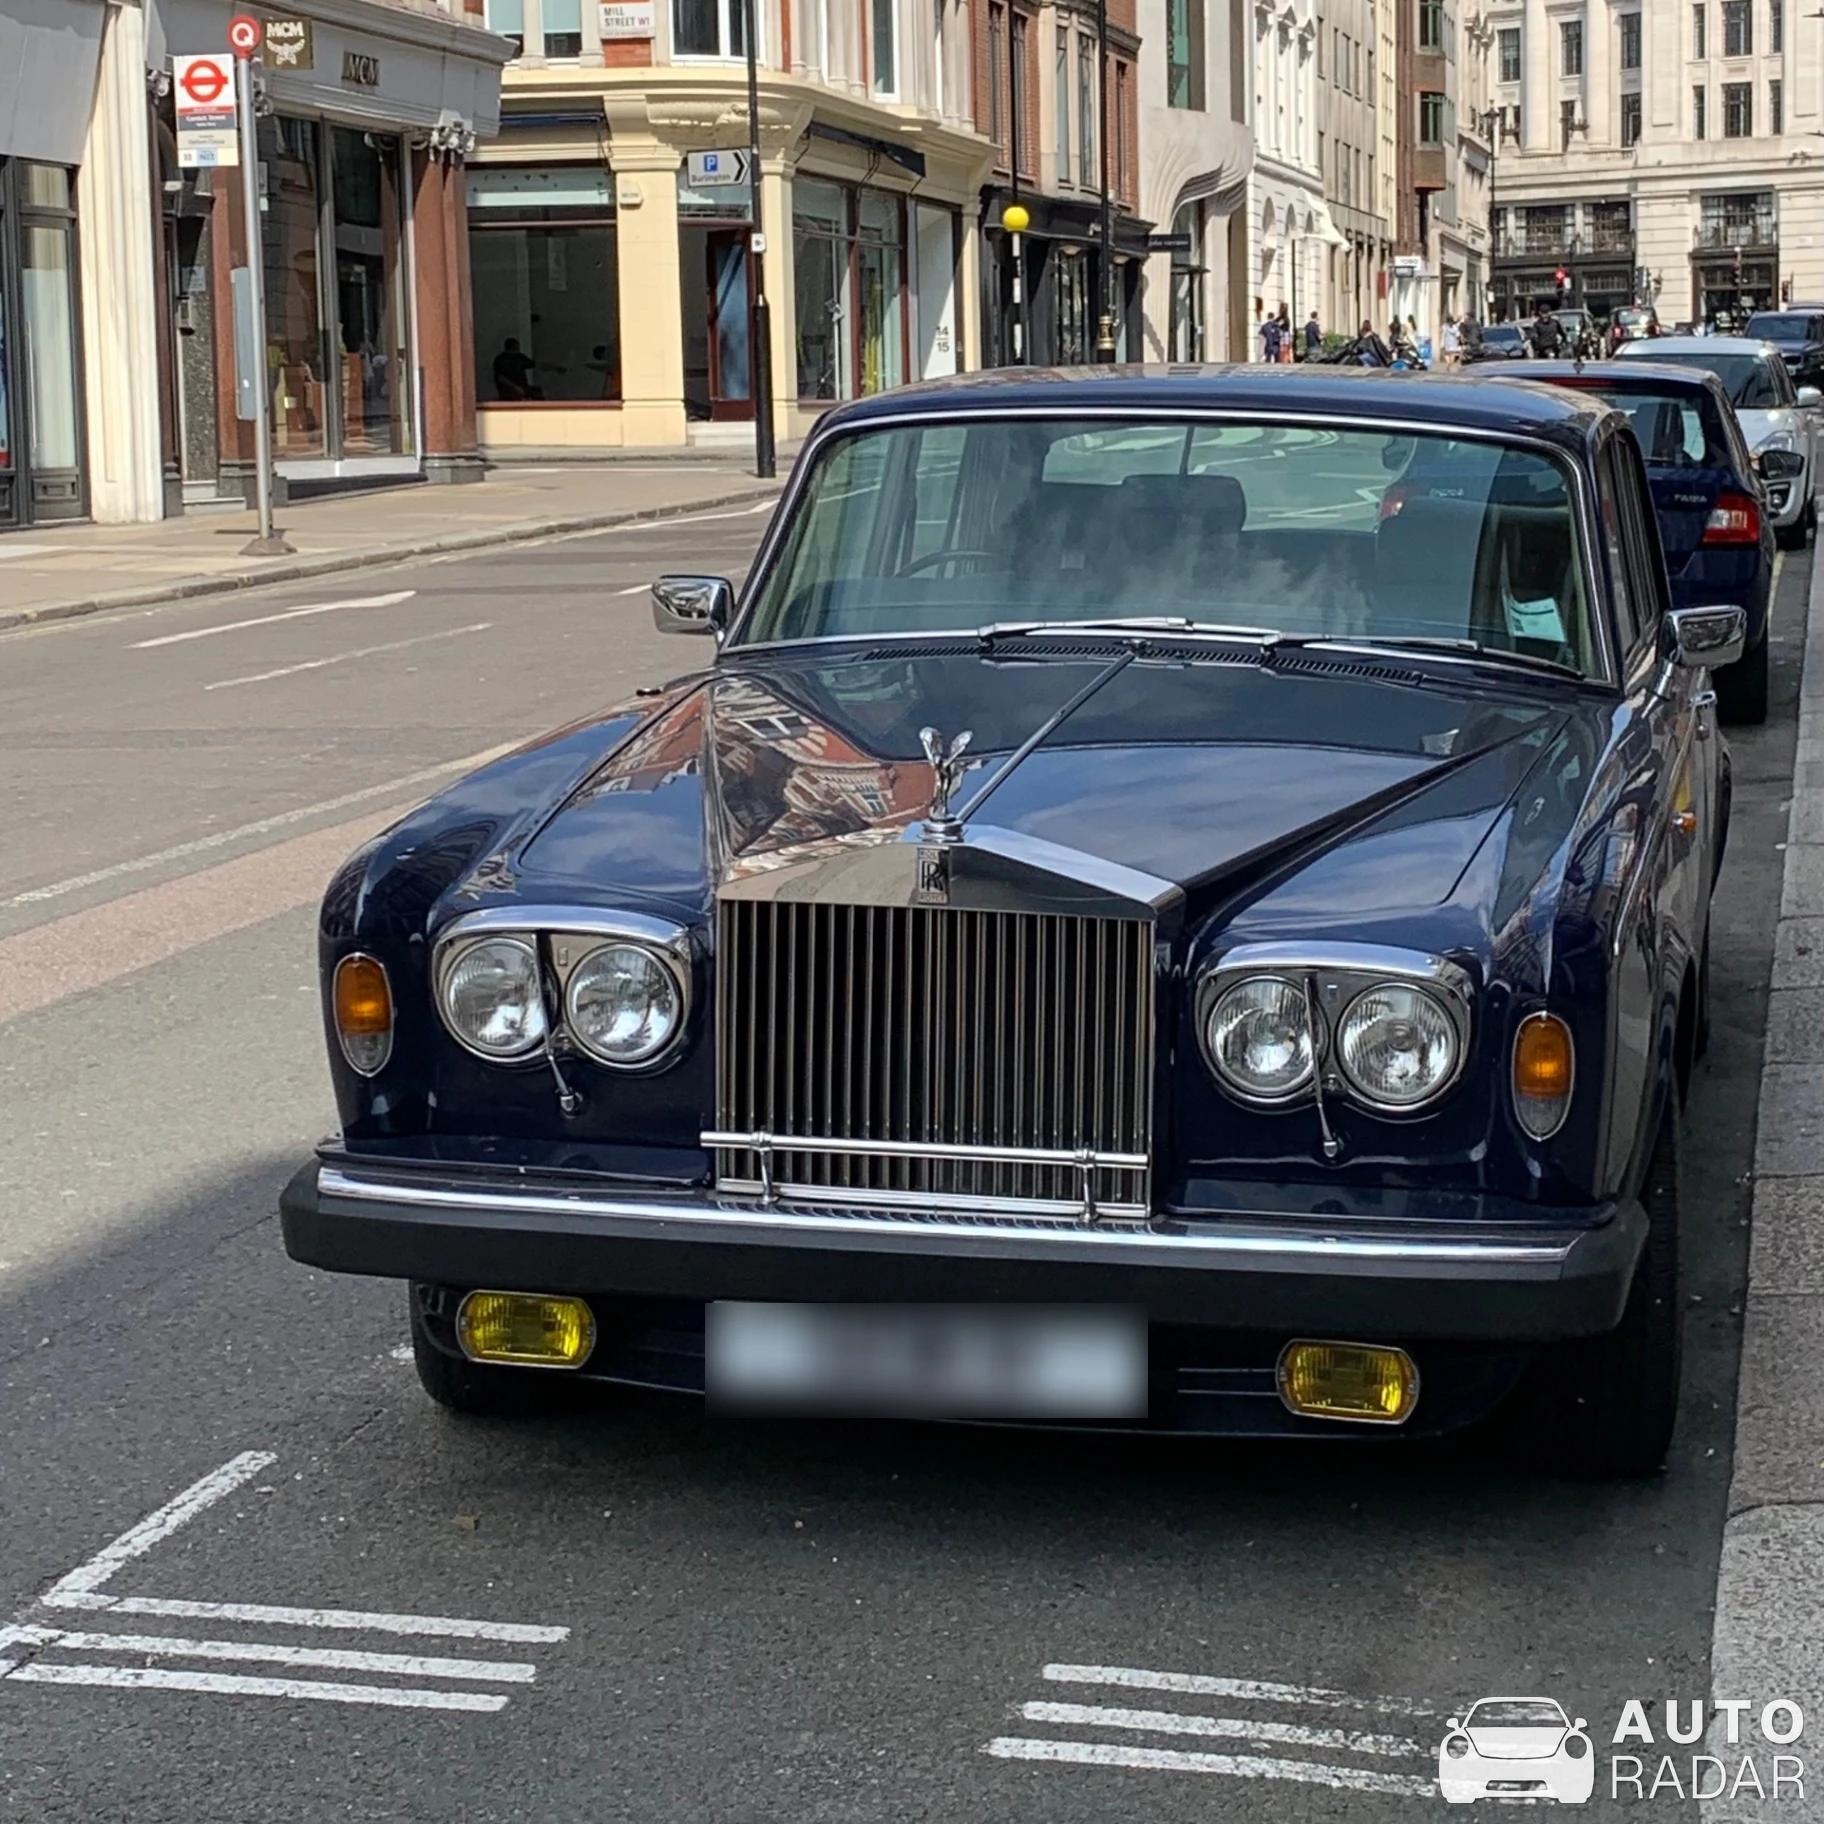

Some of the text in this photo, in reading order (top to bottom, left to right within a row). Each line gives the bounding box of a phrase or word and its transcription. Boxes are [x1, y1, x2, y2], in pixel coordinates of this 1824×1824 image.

[604, 7, 624, 16] MILL
[605, 17, 650, 27] STREET W1
[231, 22, 254, 47] Q
[266, 21, 304, 37] MCM
[706, 156, 716, 171] P
[691, 173, 731, 183] Burlington
[936, 326, 949, 336] 14
[937, 341, 950, 353] 15
